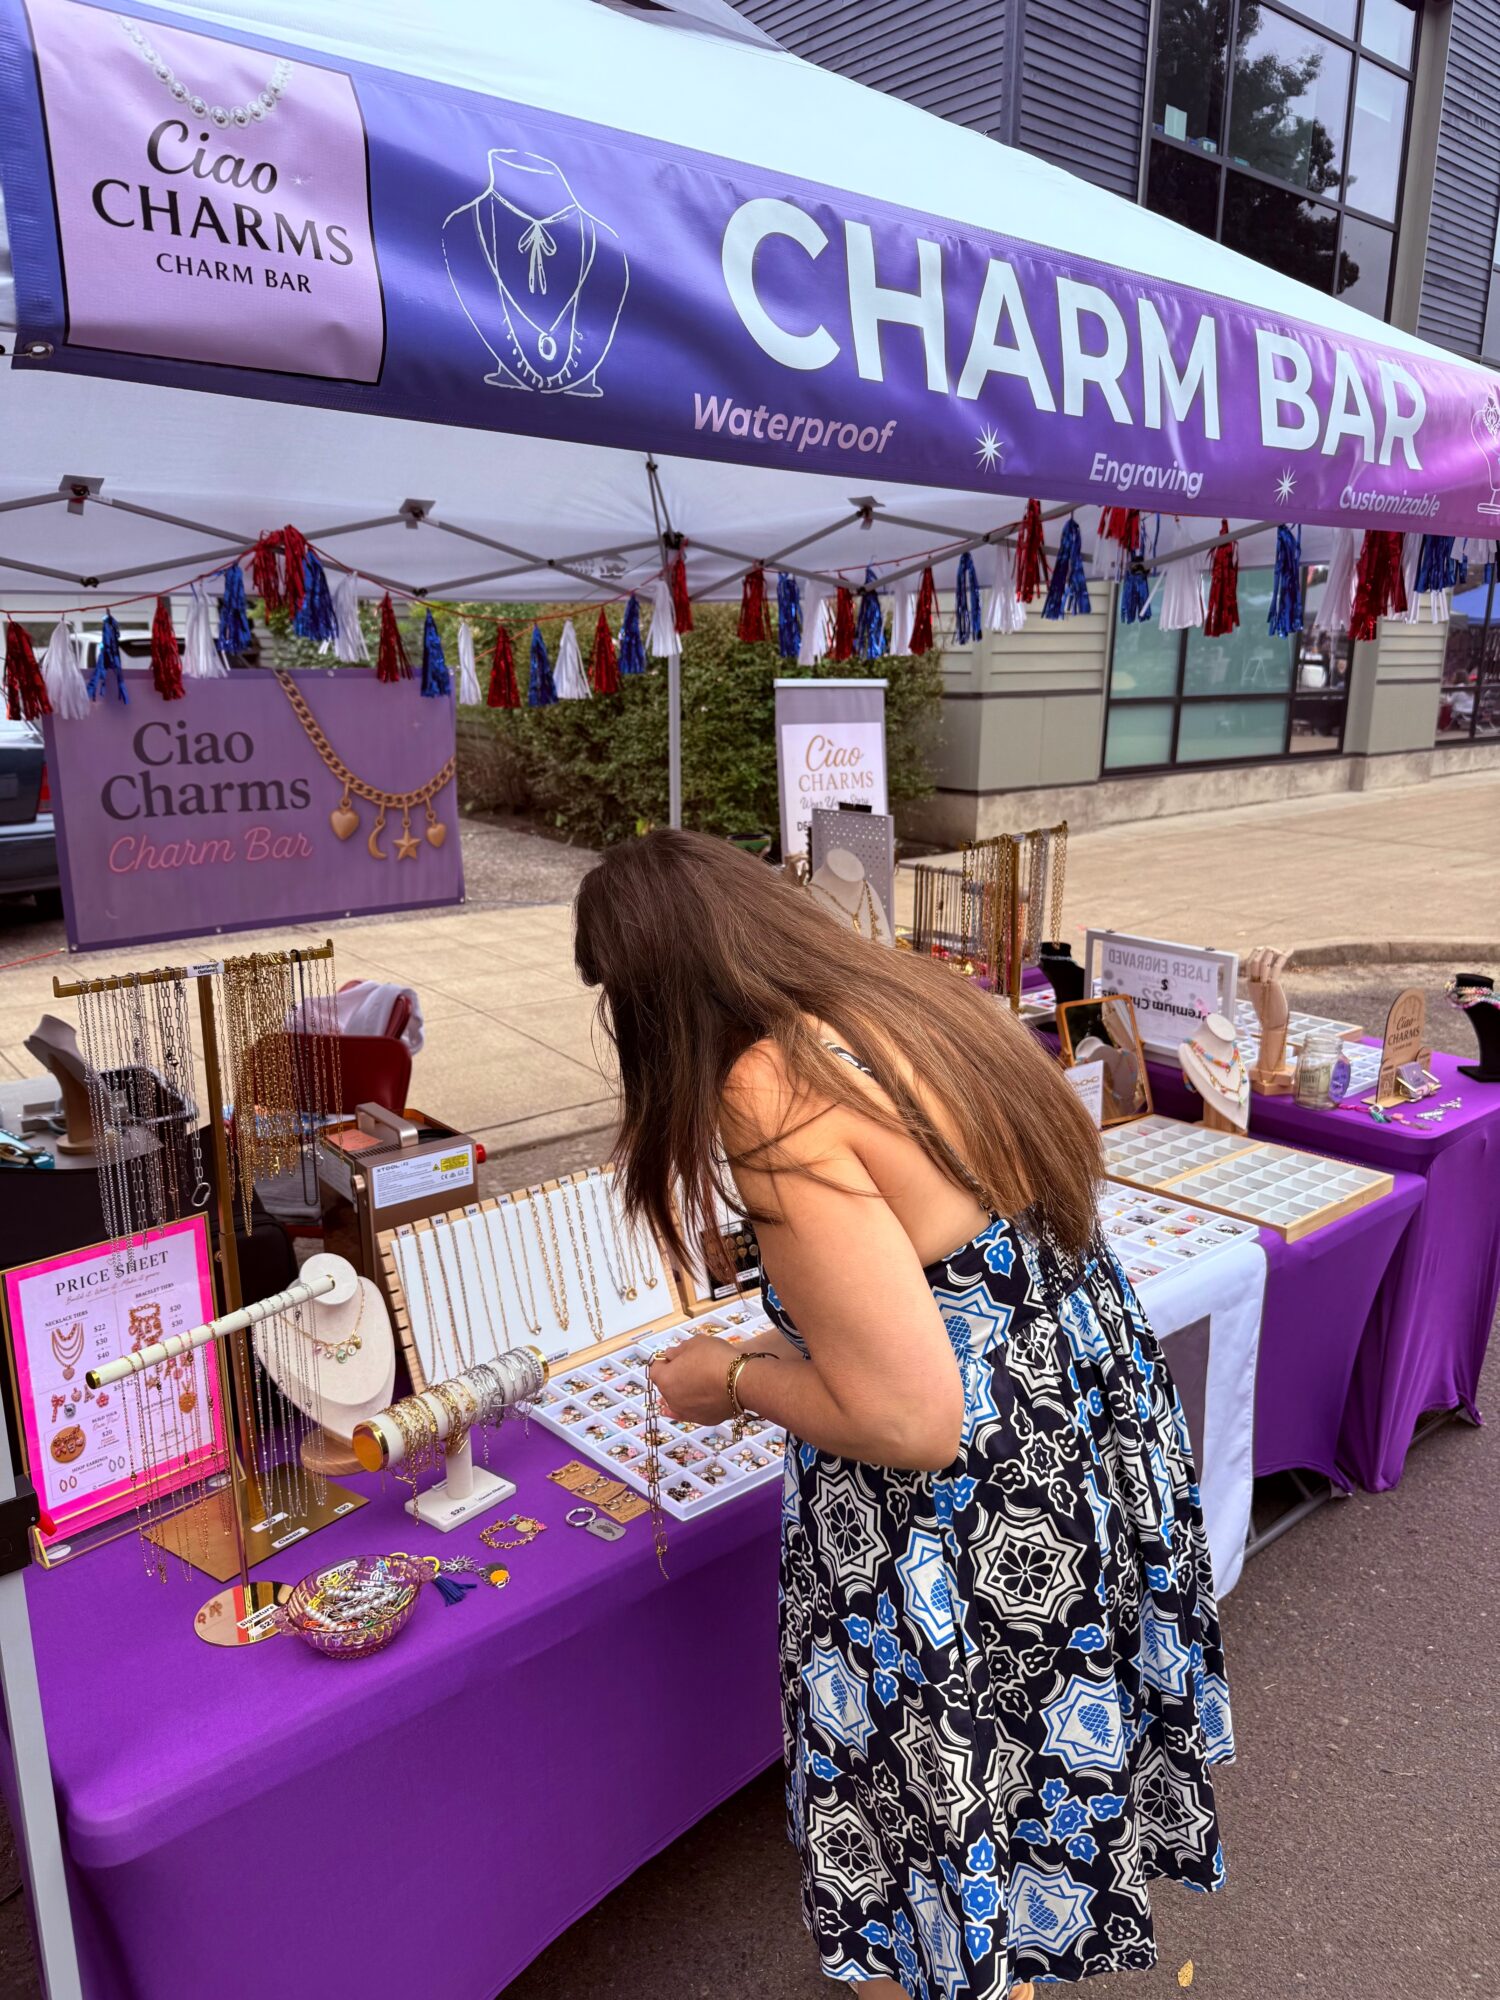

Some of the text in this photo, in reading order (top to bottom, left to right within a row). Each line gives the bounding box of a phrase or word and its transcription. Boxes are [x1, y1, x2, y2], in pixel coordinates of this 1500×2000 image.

[147, 119, 278, 195] Ciao
[91, 178, 354, 266] CHARMS
[156, 252, 312, 294] CHARM BAR
[721, 197, 1427, 471] CHARM BAR
[693, 392, 898, 454] Waterproof
[1089, 452, 1203, 500] Engraving
[1339, 486, 1440, 518] Customizable
[133, 719, 255, 767] Ciao
[805, 734, 864, 772] Ciao
[101, 770, 311, 821] Charms
[799, 770, 874, 793] CHARMS
[108, 826, 314, 874] Charm Bar
[1388, 1027, 1420, 1046] CHARMS
[1396, 1016, 1416, 1031] Ciao
[55, 1250, 168, 1296] PRICE SHEET
[135, 1282, 174, 1298] BRACELET TIERS
[45, 1310, 88, 1327] NECKLACE TIERS
[169, 1304, 181, 1313] $20
[93, 1323, 106, 1333] $22
[171, 1319, 183, 1328] $30
[95, 1337, 108, 1347] $30
[97, 1351, 110, 1361] $40
[278, 1530, 302, 1545] Classic
[240, 1604, 275, 1628] Signature
